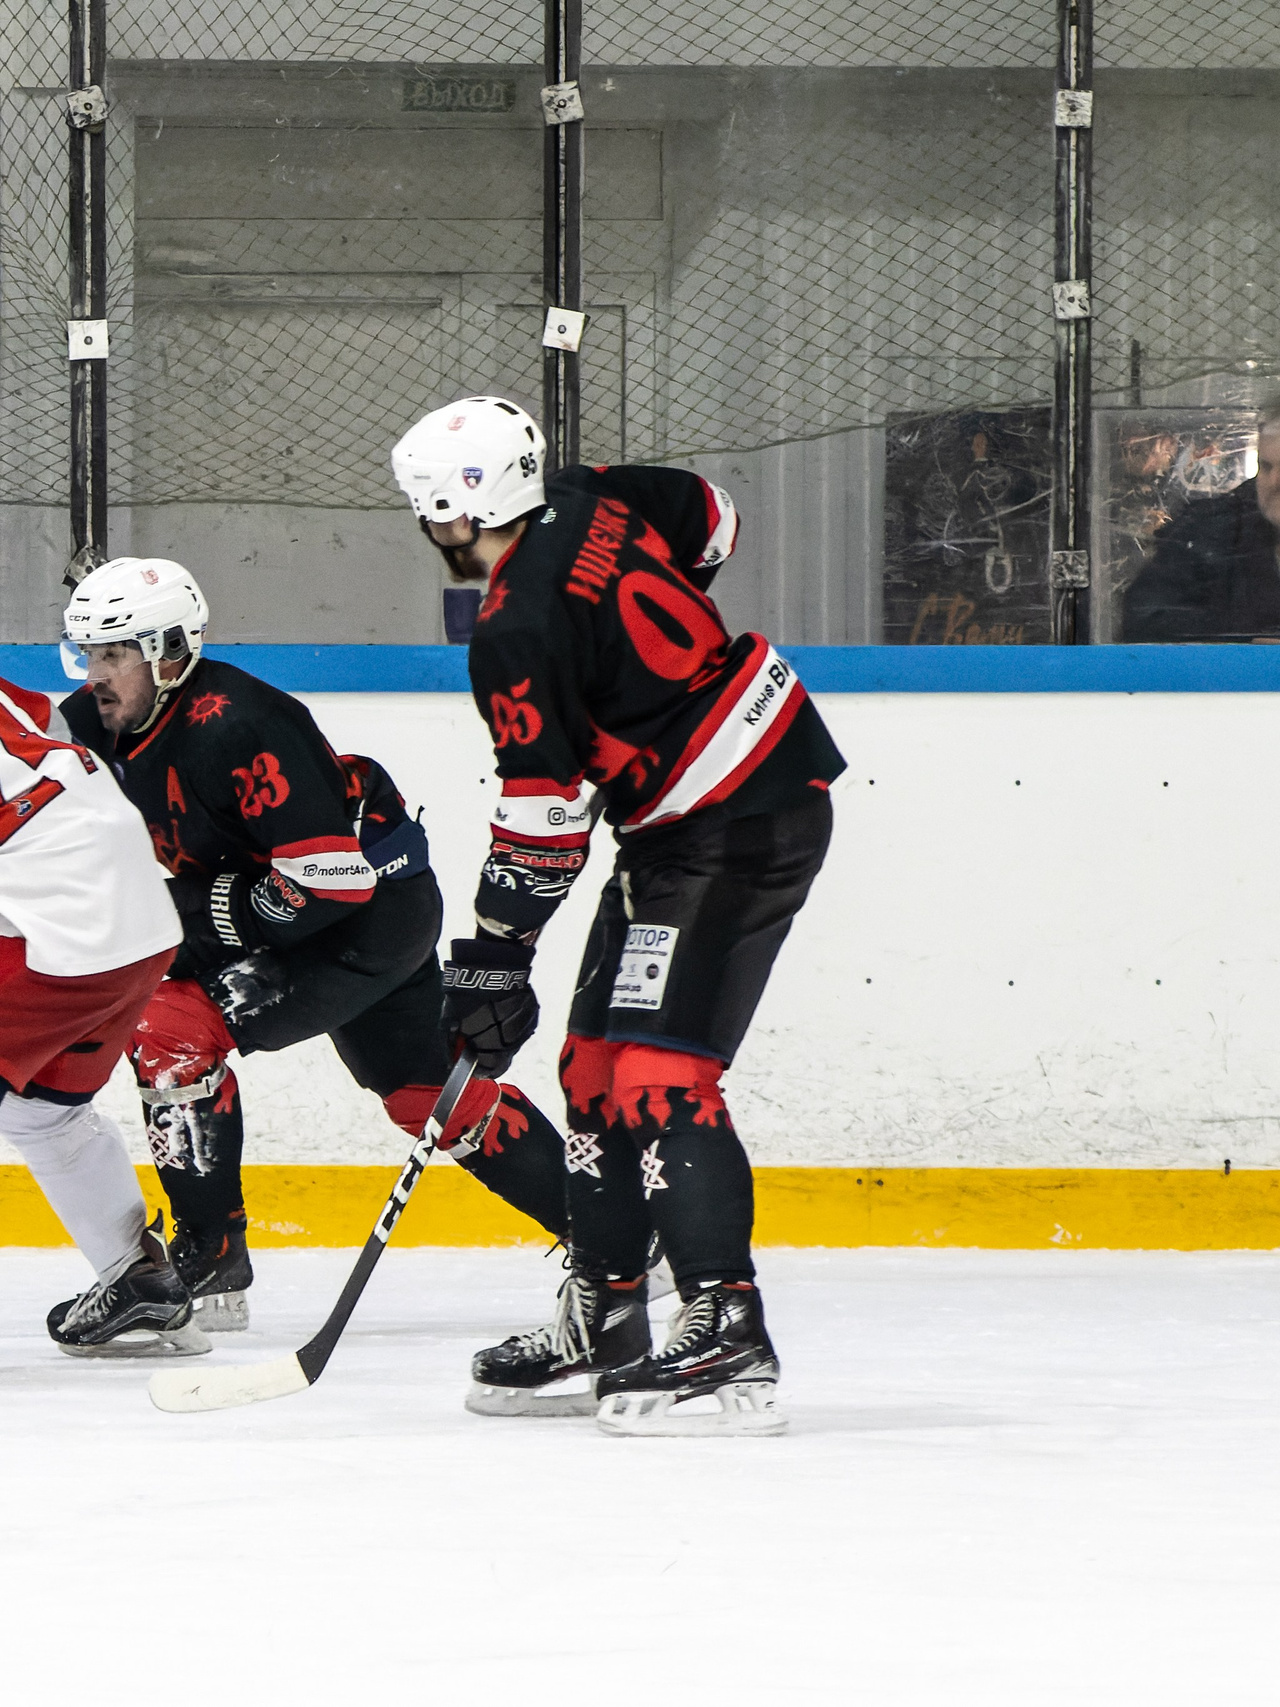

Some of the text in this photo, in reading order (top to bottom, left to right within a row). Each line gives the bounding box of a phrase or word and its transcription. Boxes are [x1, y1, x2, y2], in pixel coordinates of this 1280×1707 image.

[519, 452, 538, 479] 95
[490, 677, 543, 748] 95
[231, 752, 290, 820] 23
[373, 1114, 445, 1244] CCM
